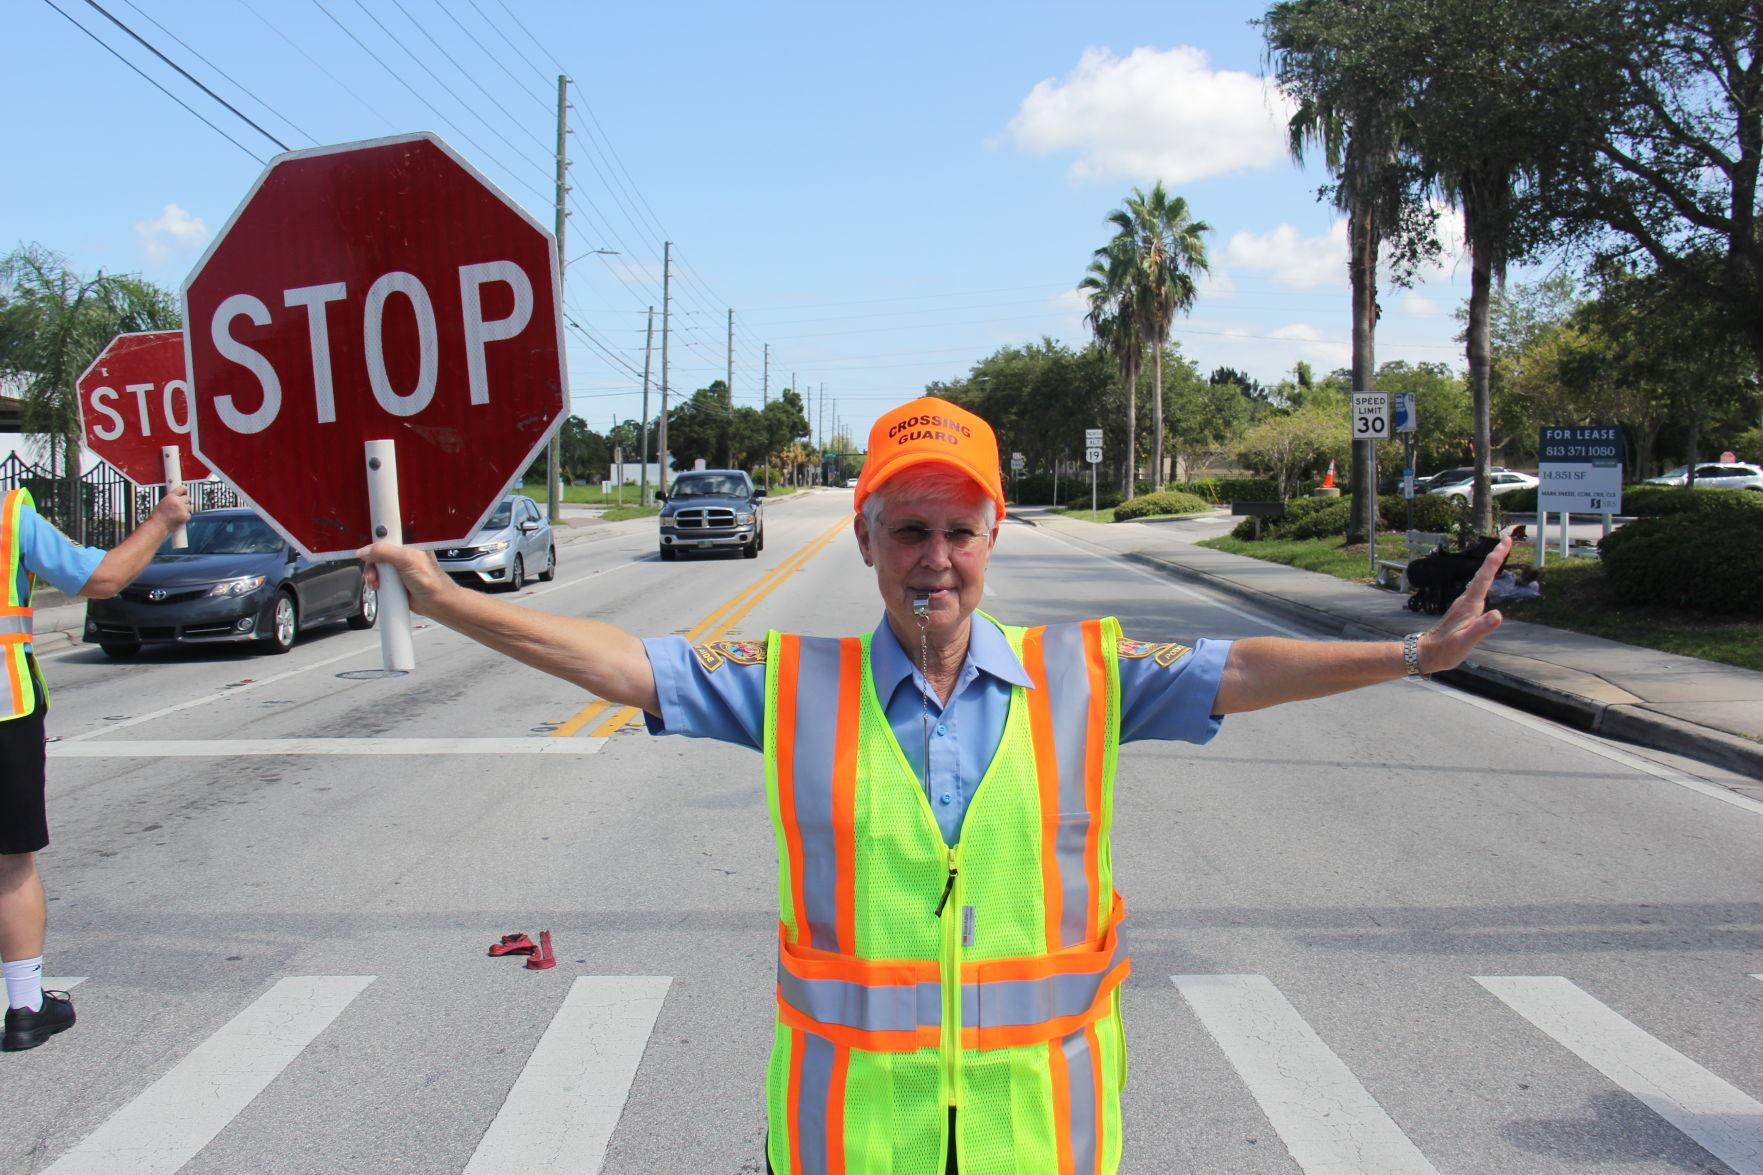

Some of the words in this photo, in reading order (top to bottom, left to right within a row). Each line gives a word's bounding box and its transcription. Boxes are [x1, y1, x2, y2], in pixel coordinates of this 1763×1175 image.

[210, 260, 534, 435] STOP
[1355, 397, 1386, 405] SPEED
[90, 380, 192, 441] STO
[1358, 407, 1382, 415] LIMIT
[888, 415, 971, 438] CROSSING
[1357, 416, 1385, 433] 30
[898, 430, 958, 445] GUARD
[1546, 429, 1571, 439] FOR
[1576, 429, 1616, 439] LEASE
[1089, 450, 1100, 461] 19
[1546, 446, 1565, 456] 813
[1542, 471, 1572, 481] 14,851
[1574, 471, 1587, 480] SF
